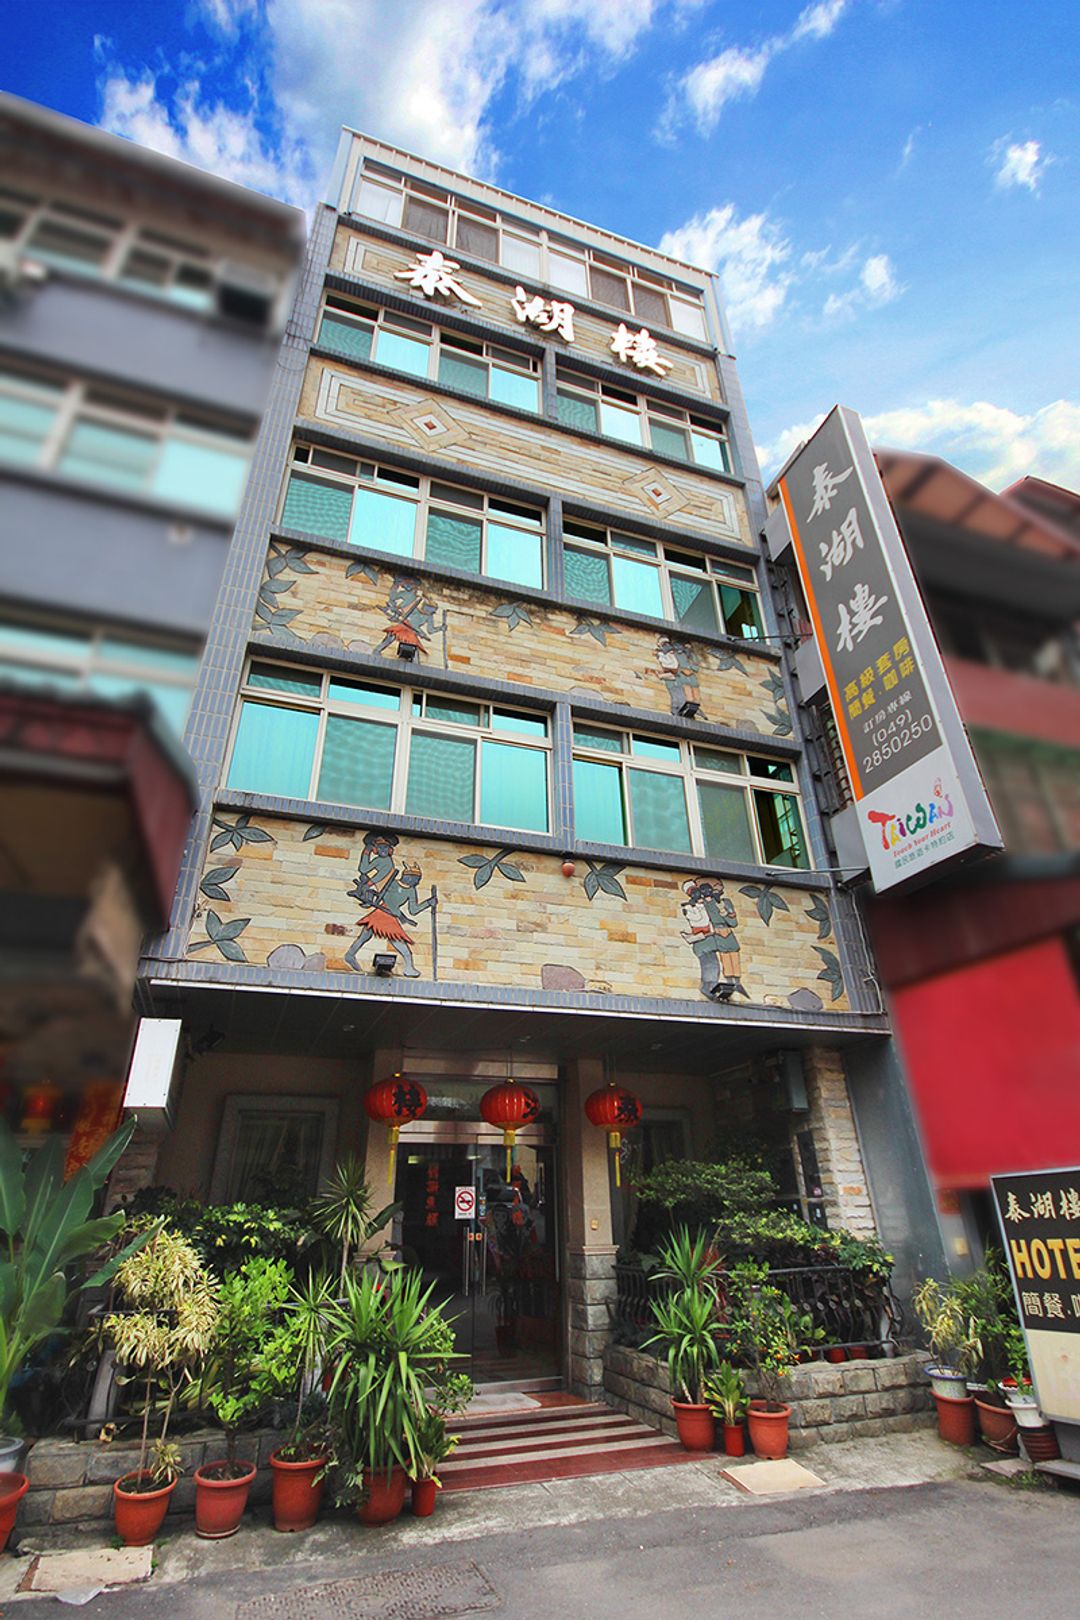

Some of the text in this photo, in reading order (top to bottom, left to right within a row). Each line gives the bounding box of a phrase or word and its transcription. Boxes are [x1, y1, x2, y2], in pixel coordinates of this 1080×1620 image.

[806, 461, 888, 653] 泰湖樓
[862, 714, 933, 773] 2850250
[872, 709, 912, 746] (049)
